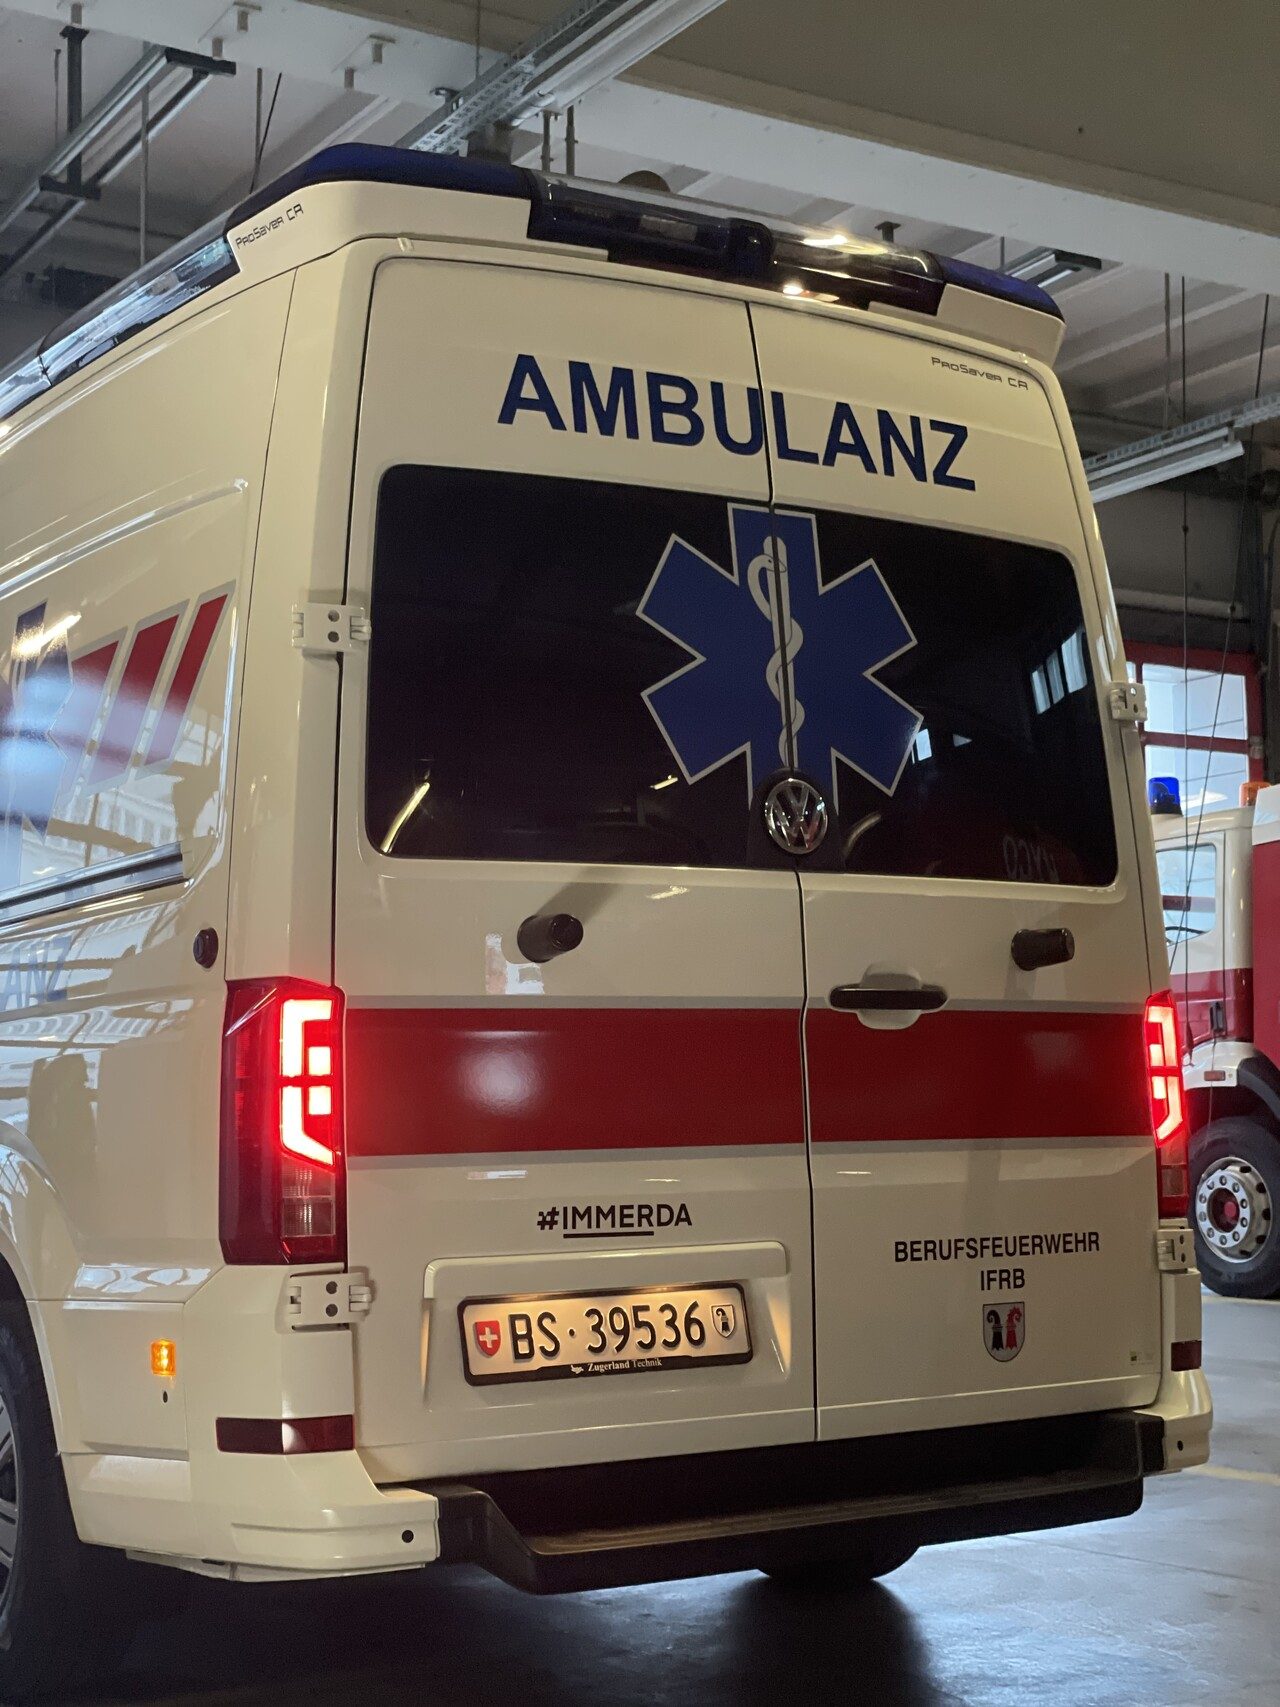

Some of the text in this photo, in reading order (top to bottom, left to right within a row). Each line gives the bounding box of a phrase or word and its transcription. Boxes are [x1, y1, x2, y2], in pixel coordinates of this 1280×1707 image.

[497, 353, 976, 492] AMBULANZ
[536, 1203, 693, 1231] #IMMERDA
[894, 1231, 1100, 1263] BERUFSFEUERWEHR
[980, 1268, 1025, 1291] IFRB
[587, 1357, 663, 1373] Zugerland Technik
